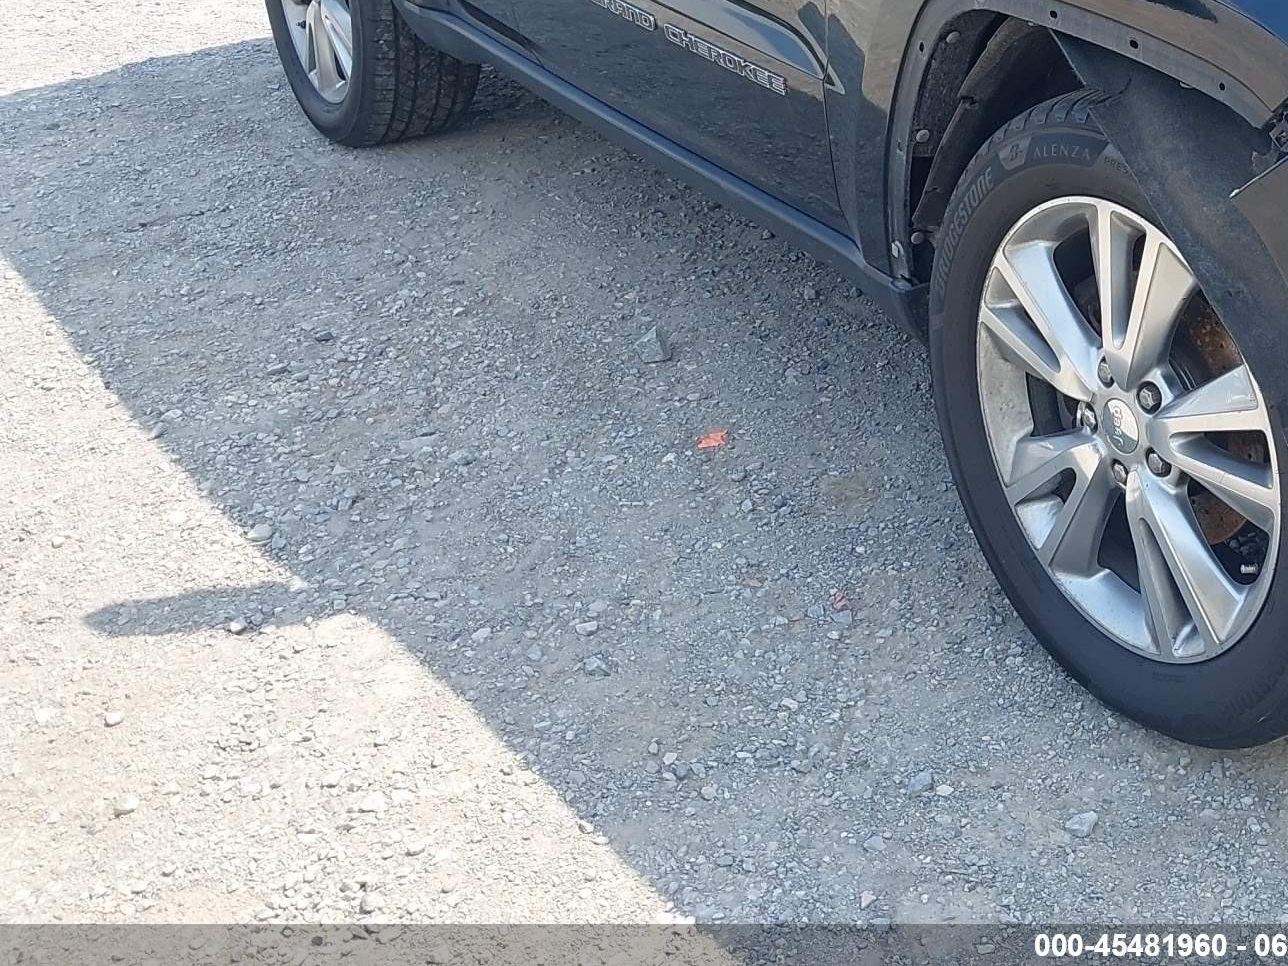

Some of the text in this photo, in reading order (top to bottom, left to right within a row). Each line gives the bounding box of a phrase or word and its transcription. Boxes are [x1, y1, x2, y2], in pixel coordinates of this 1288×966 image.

[663, 23, 788, 96] CHEROKEE
[1032, 143, 1091, 161] ALENZA
[1103, 155, 1131, 176] PRES
[935, 165, 995, 293] BRIDGESTONE
[1112, 405, 1124, 447] Jeep
